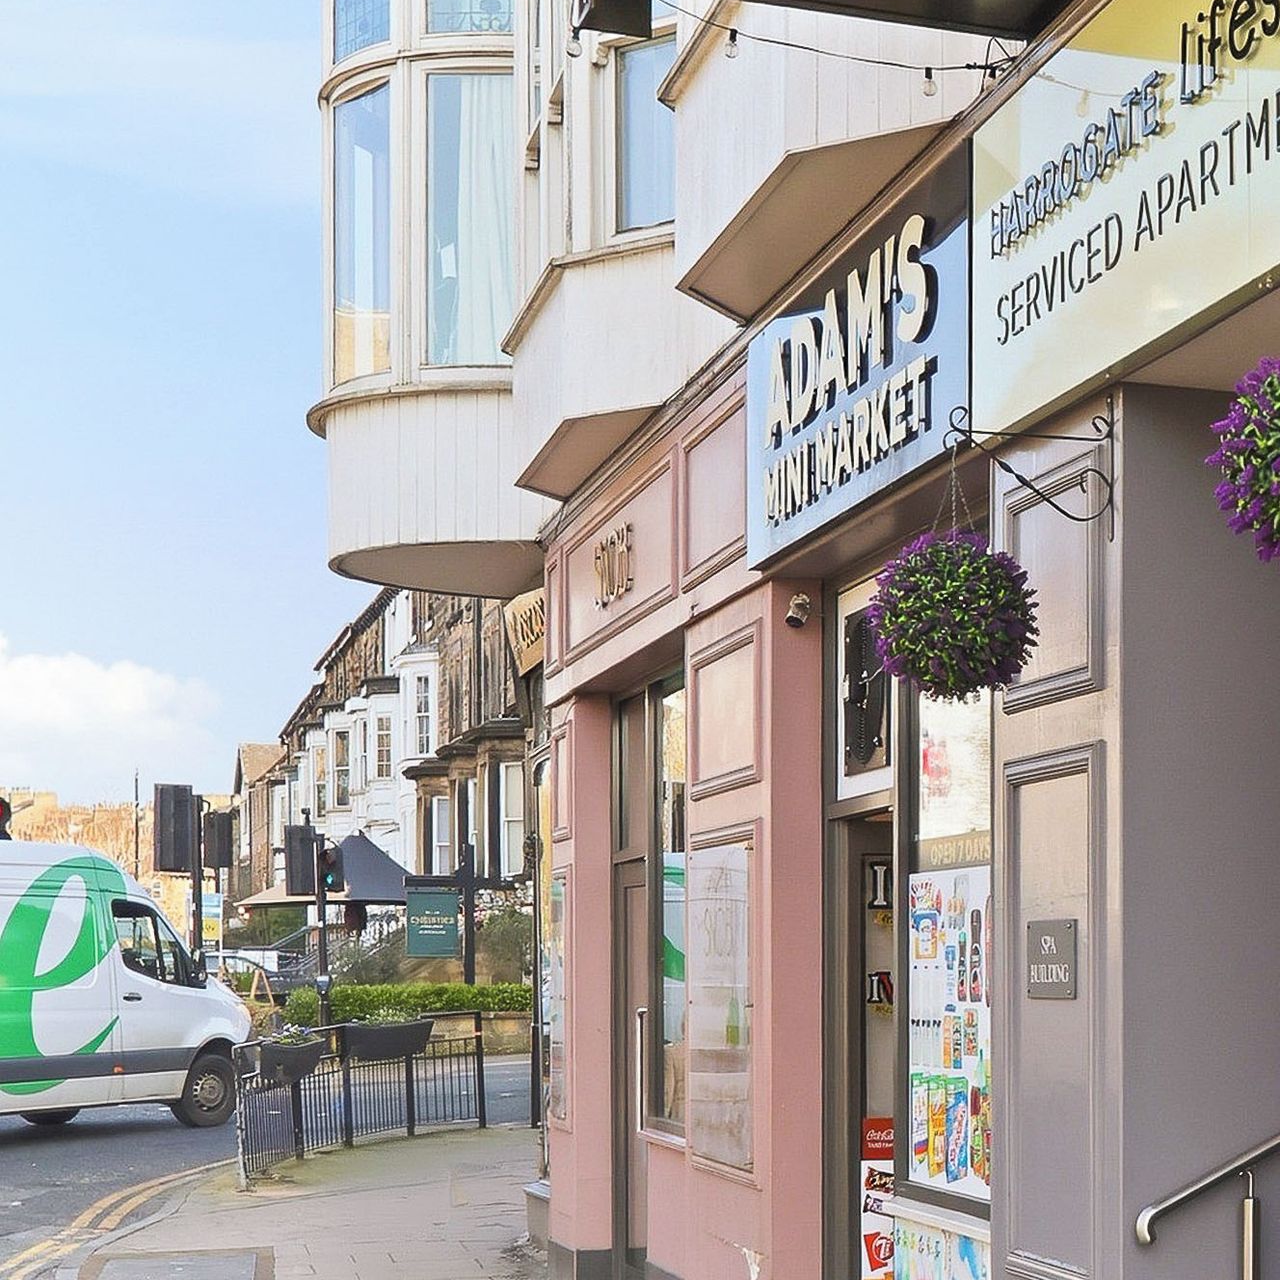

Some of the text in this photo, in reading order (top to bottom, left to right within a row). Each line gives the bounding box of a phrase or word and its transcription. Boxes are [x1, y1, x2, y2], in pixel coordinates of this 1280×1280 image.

[990, 70, 1165, 259] HARROGATE
[764, 214, 927, 450] ADAM'S
[997, 212, 1124, 345] SERVICED
[764, 354, 930, 526] MINI MARKET
[1040, 935, 1057, 954] SPA
